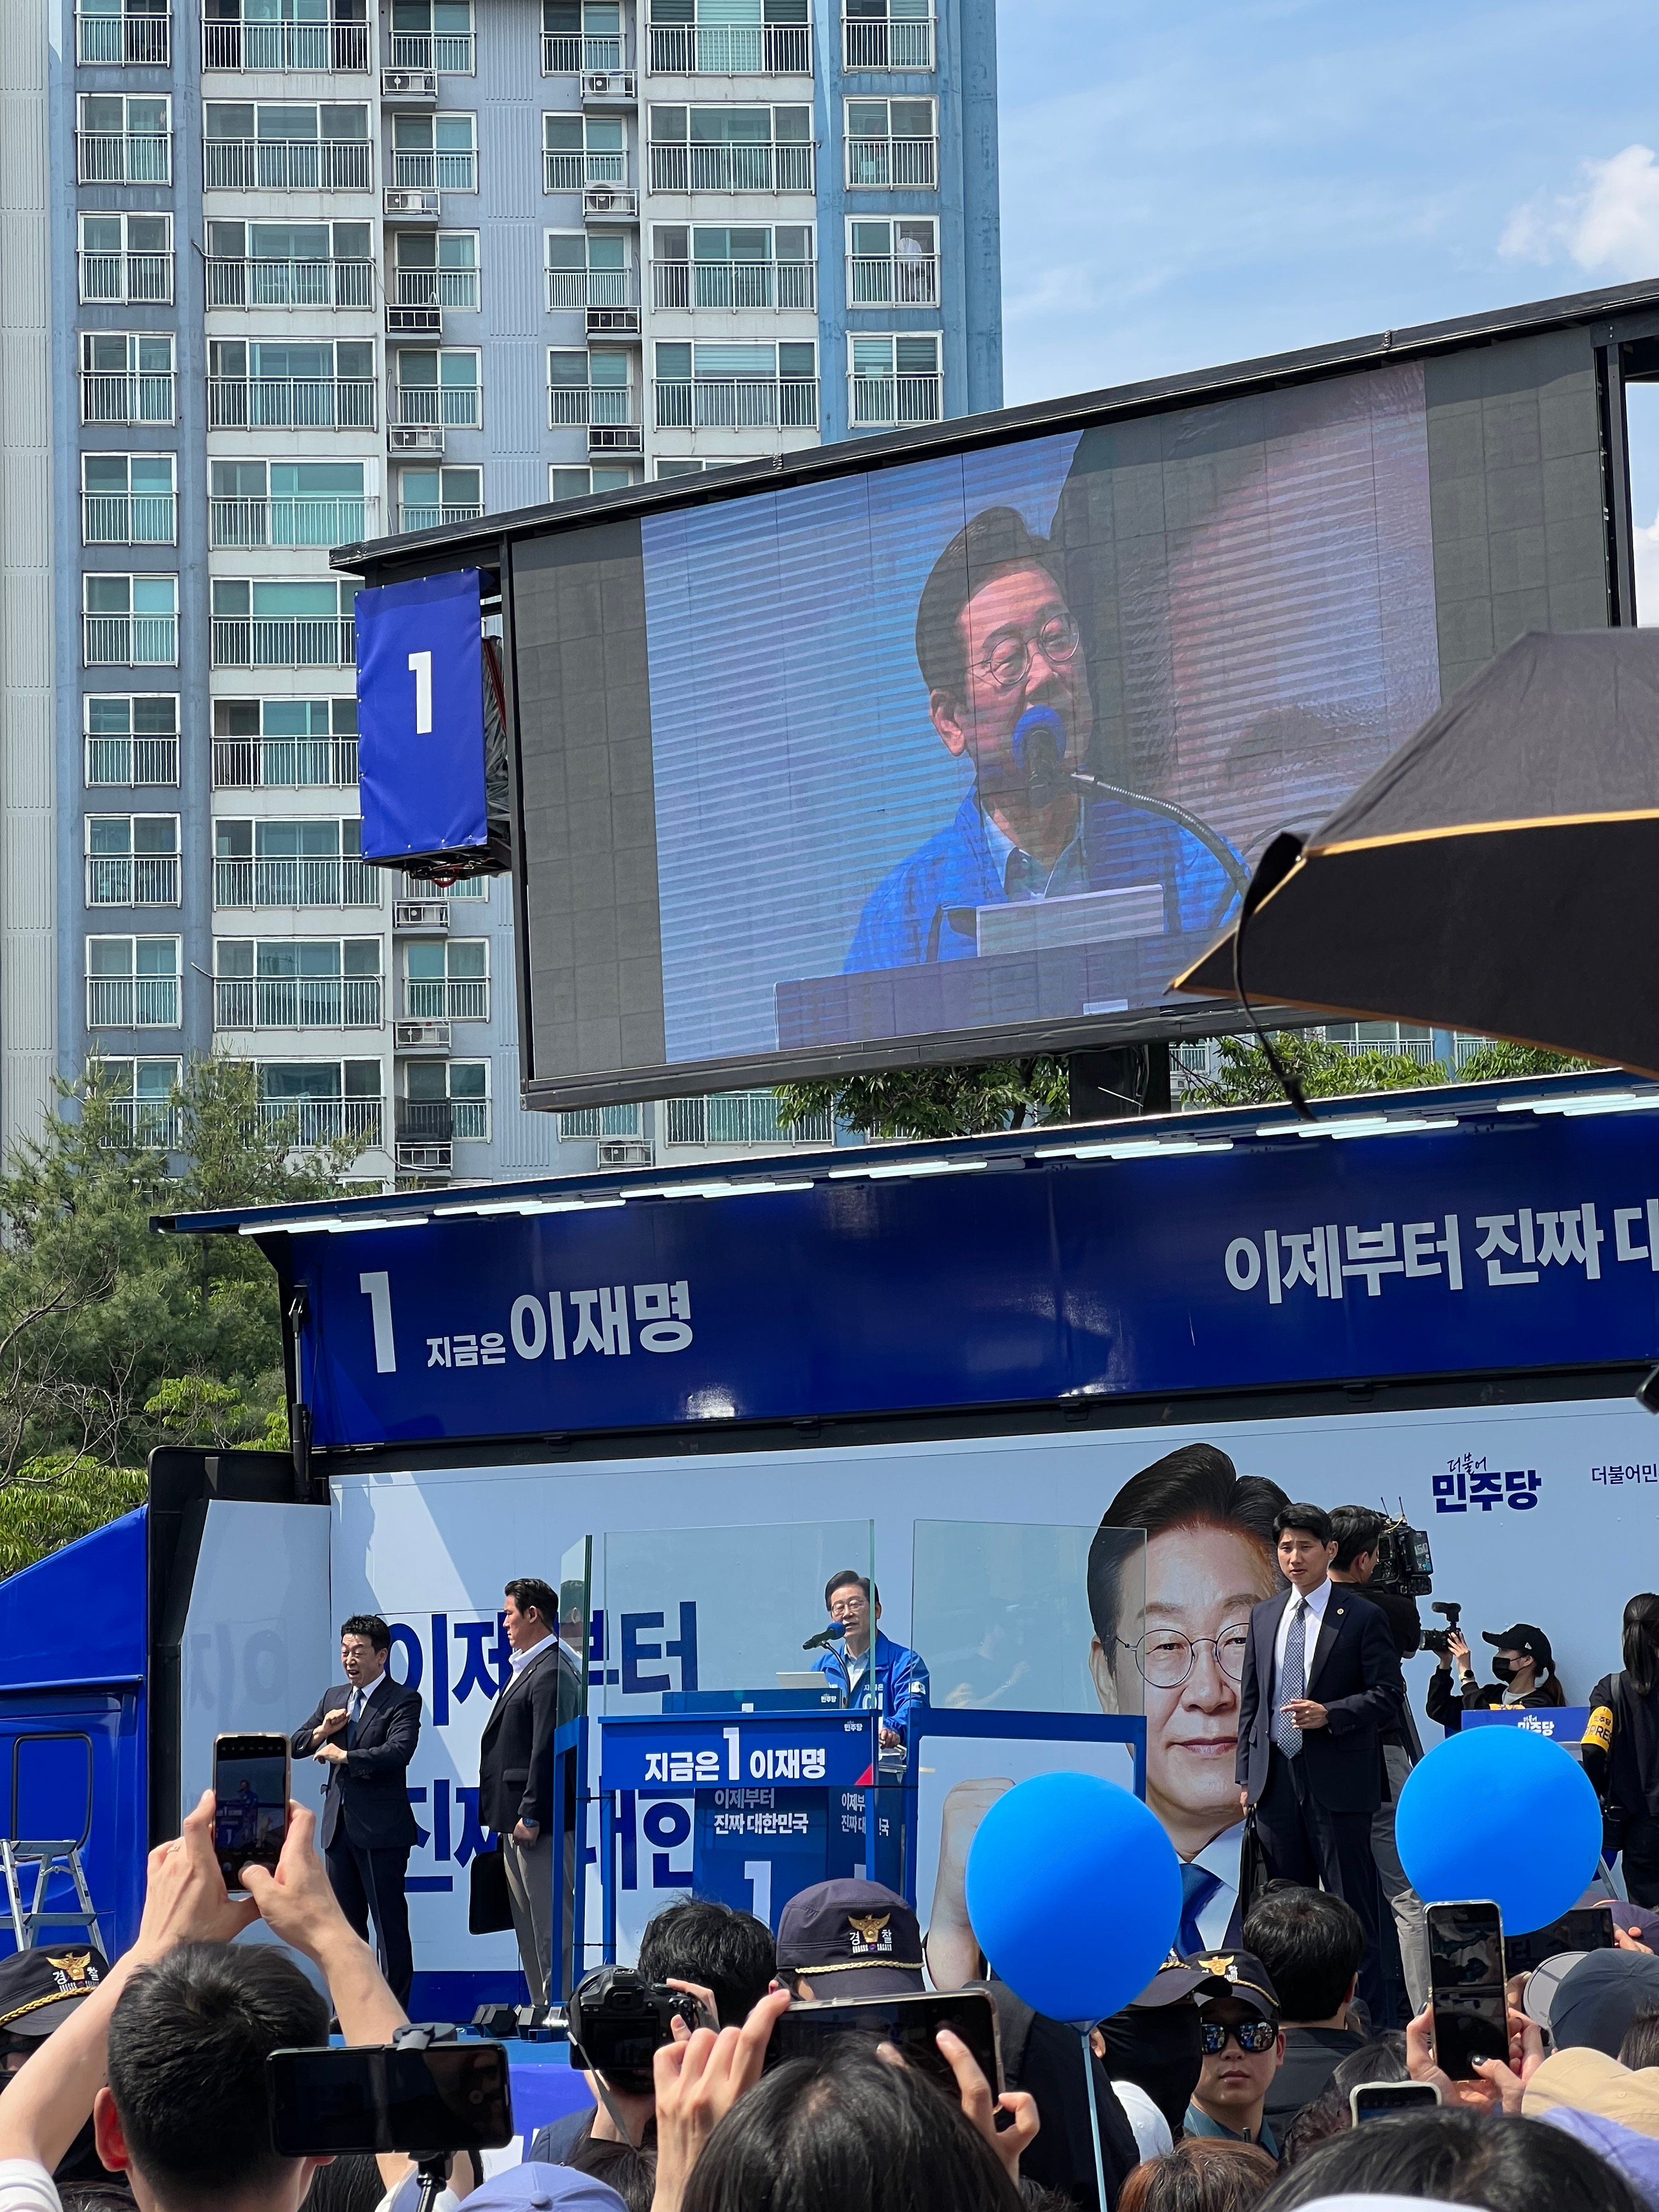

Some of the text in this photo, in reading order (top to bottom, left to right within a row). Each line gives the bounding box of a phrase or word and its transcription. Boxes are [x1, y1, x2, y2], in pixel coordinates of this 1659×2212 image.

[408, 651, 432, 734] 1
[1224, 1214, 1463, 1304] 이제부터
[1476, 1203, 1604, 1286] 진짜
[359, 1271, 693, 1373] 1 지금은 이재명
[1447, 1452, 1487, 1475] 더불어
[1592, 1463, 1658, 1485] 더불어민
[1432, 1470, 1542, 1514] 민주당
[844, 1723, 863, 1731] 민주당
[645, 1727, 826, 1782] 지금은 1 이재명
[714, 1787, 775, 1809] 이제부터
[841, 1792, 866, 1812] 이제부
[713, 1813, 809, 1835] 진짜 대한민국
[841, 1814, 857, 1833] 진짜
[744, 1861, 771, 1929] 1
